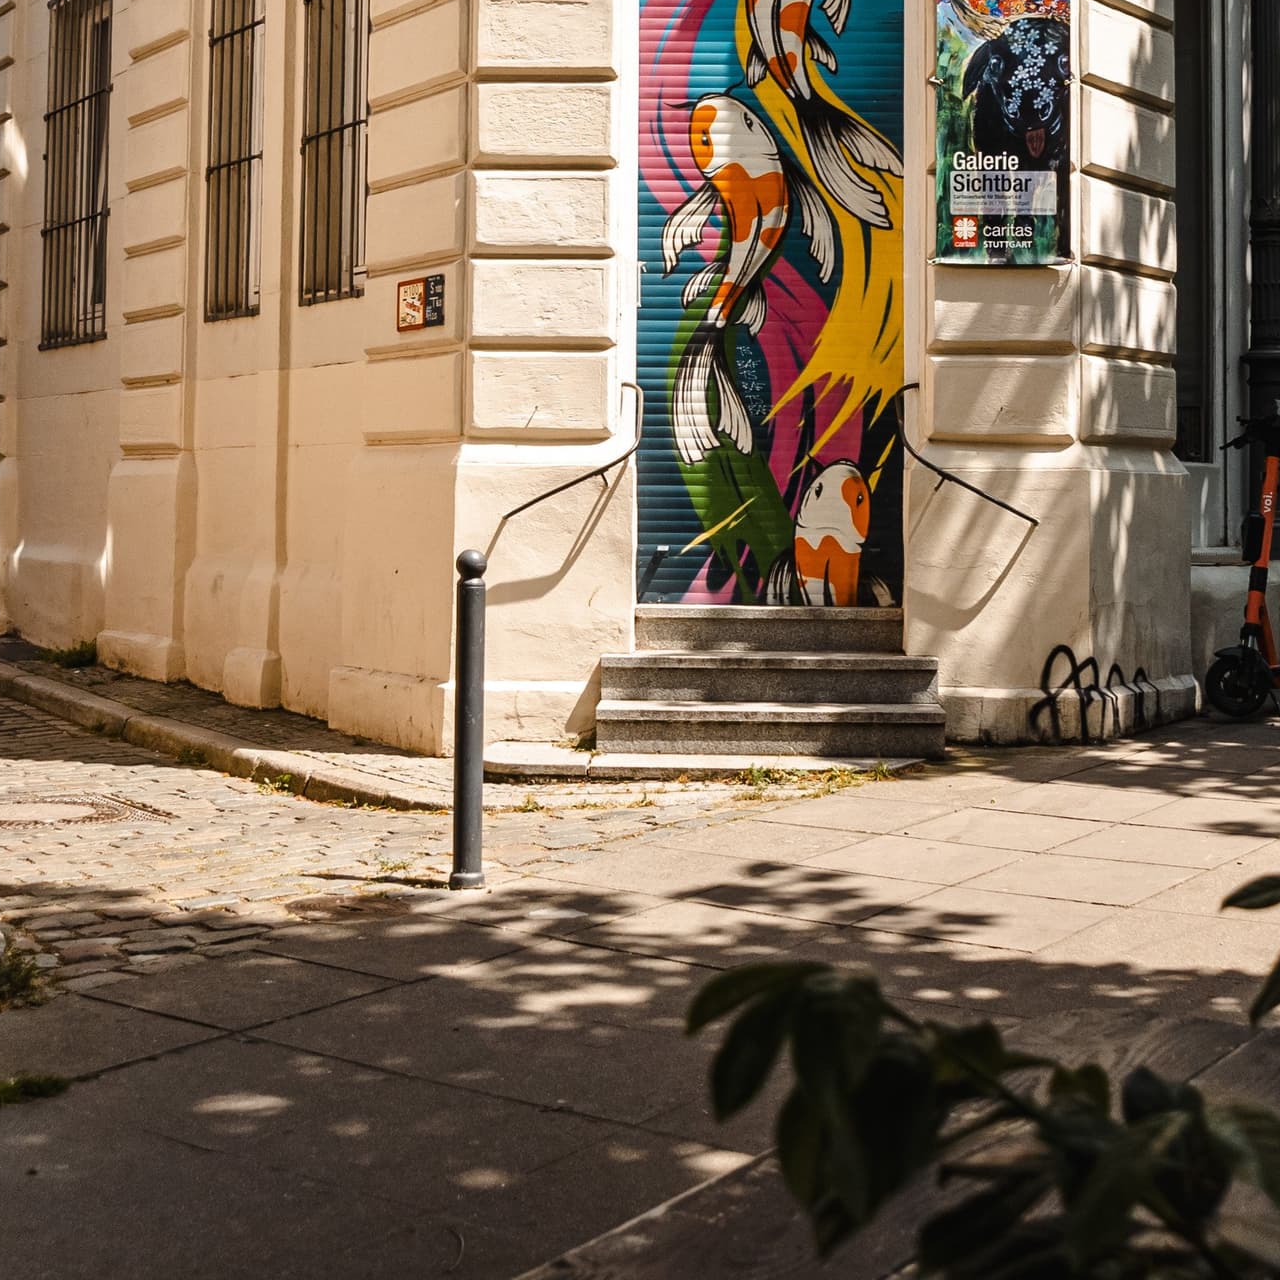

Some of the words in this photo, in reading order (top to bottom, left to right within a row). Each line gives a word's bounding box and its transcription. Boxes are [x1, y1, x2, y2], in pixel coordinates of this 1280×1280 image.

[953, 151, 1019, 170] Galerie
[953, 174, 1032, 192] Sichtbar
[983, 223, 1033, 237] caritas
[983, 240, 1033, 249] STUTTGART
[1263, 491, 1273, 513] voi.
